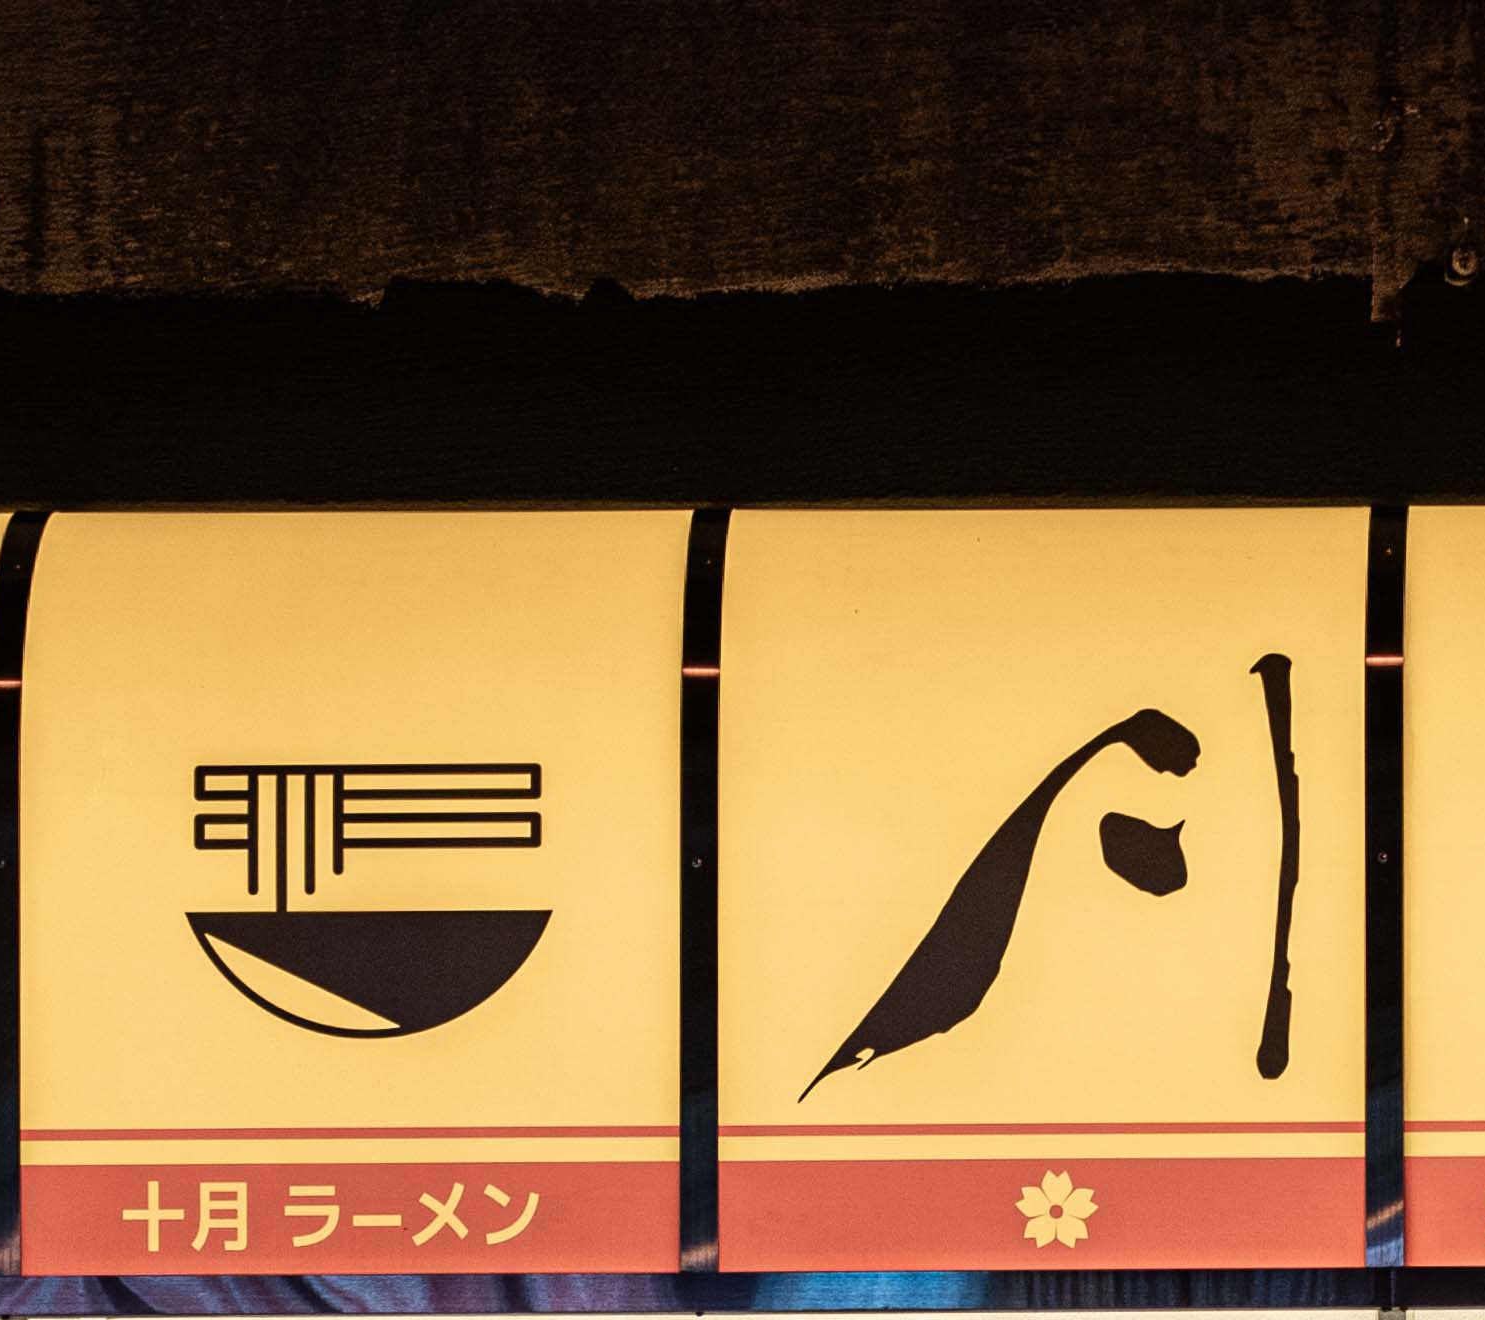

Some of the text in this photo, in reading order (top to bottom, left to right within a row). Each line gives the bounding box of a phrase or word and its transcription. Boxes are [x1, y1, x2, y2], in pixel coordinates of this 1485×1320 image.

[122, 1180, 541, 1252] 十月 ラーメン
